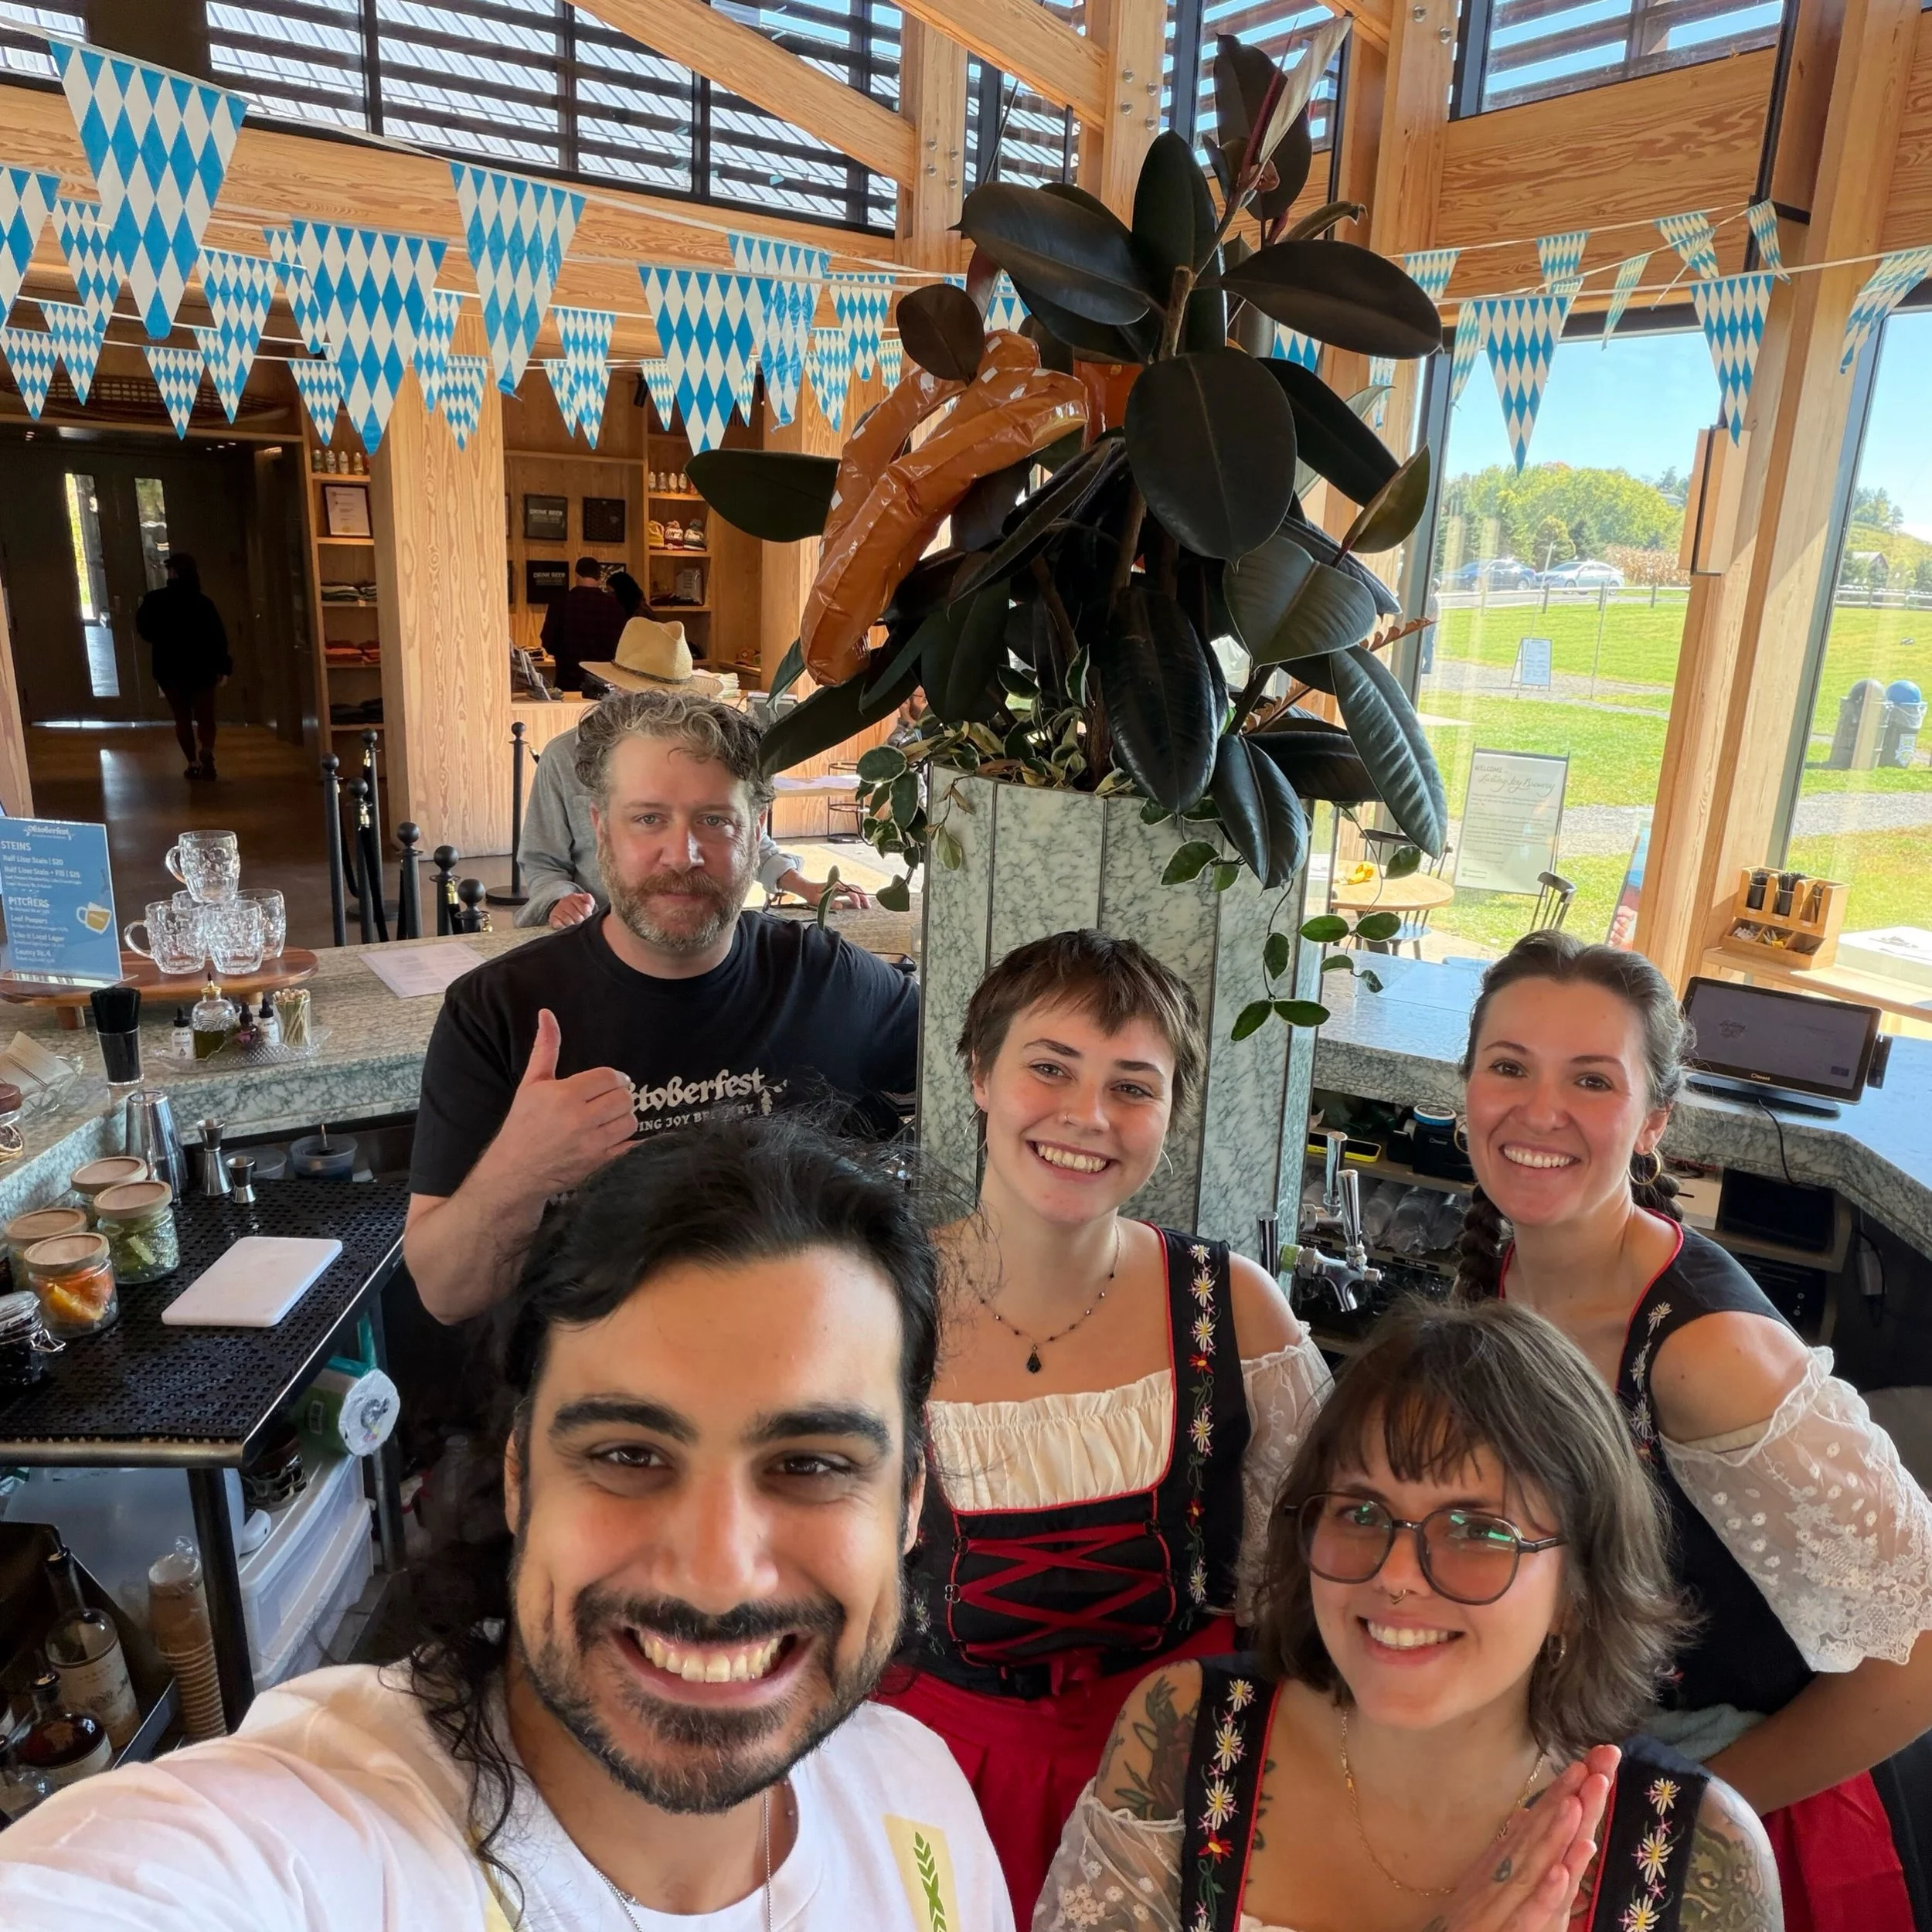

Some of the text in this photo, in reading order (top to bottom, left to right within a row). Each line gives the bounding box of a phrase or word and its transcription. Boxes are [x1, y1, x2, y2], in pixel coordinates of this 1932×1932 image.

[1478, 773, 1556, 798] Lasting Joy Brewery
[1, 840, 32, 851] STEINS
[8, 896, 50, 908] PITCHERS
[666, 1114, 689, 1128] JOY
